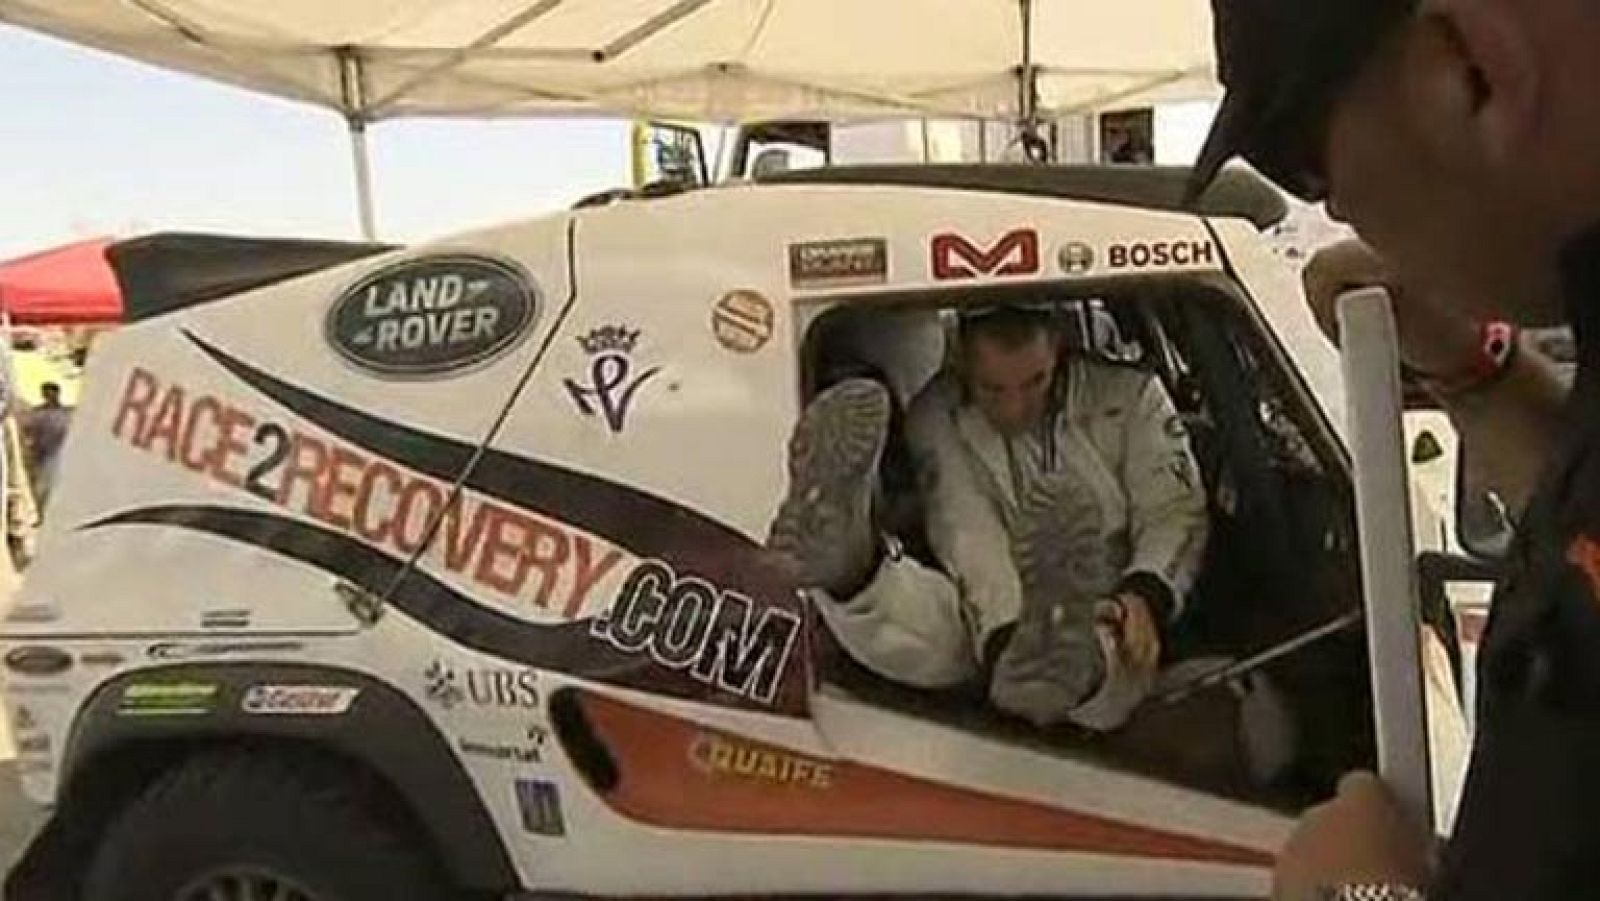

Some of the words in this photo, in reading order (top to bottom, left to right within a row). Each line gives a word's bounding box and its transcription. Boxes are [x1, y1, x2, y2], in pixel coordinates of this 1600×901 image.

[1108, 240, 1213, 268] BOSCH
[364, 274, 464, 317] LAND
[375, 306, 499, 351] ROVER
[467, 669, 540, 708] UBS
